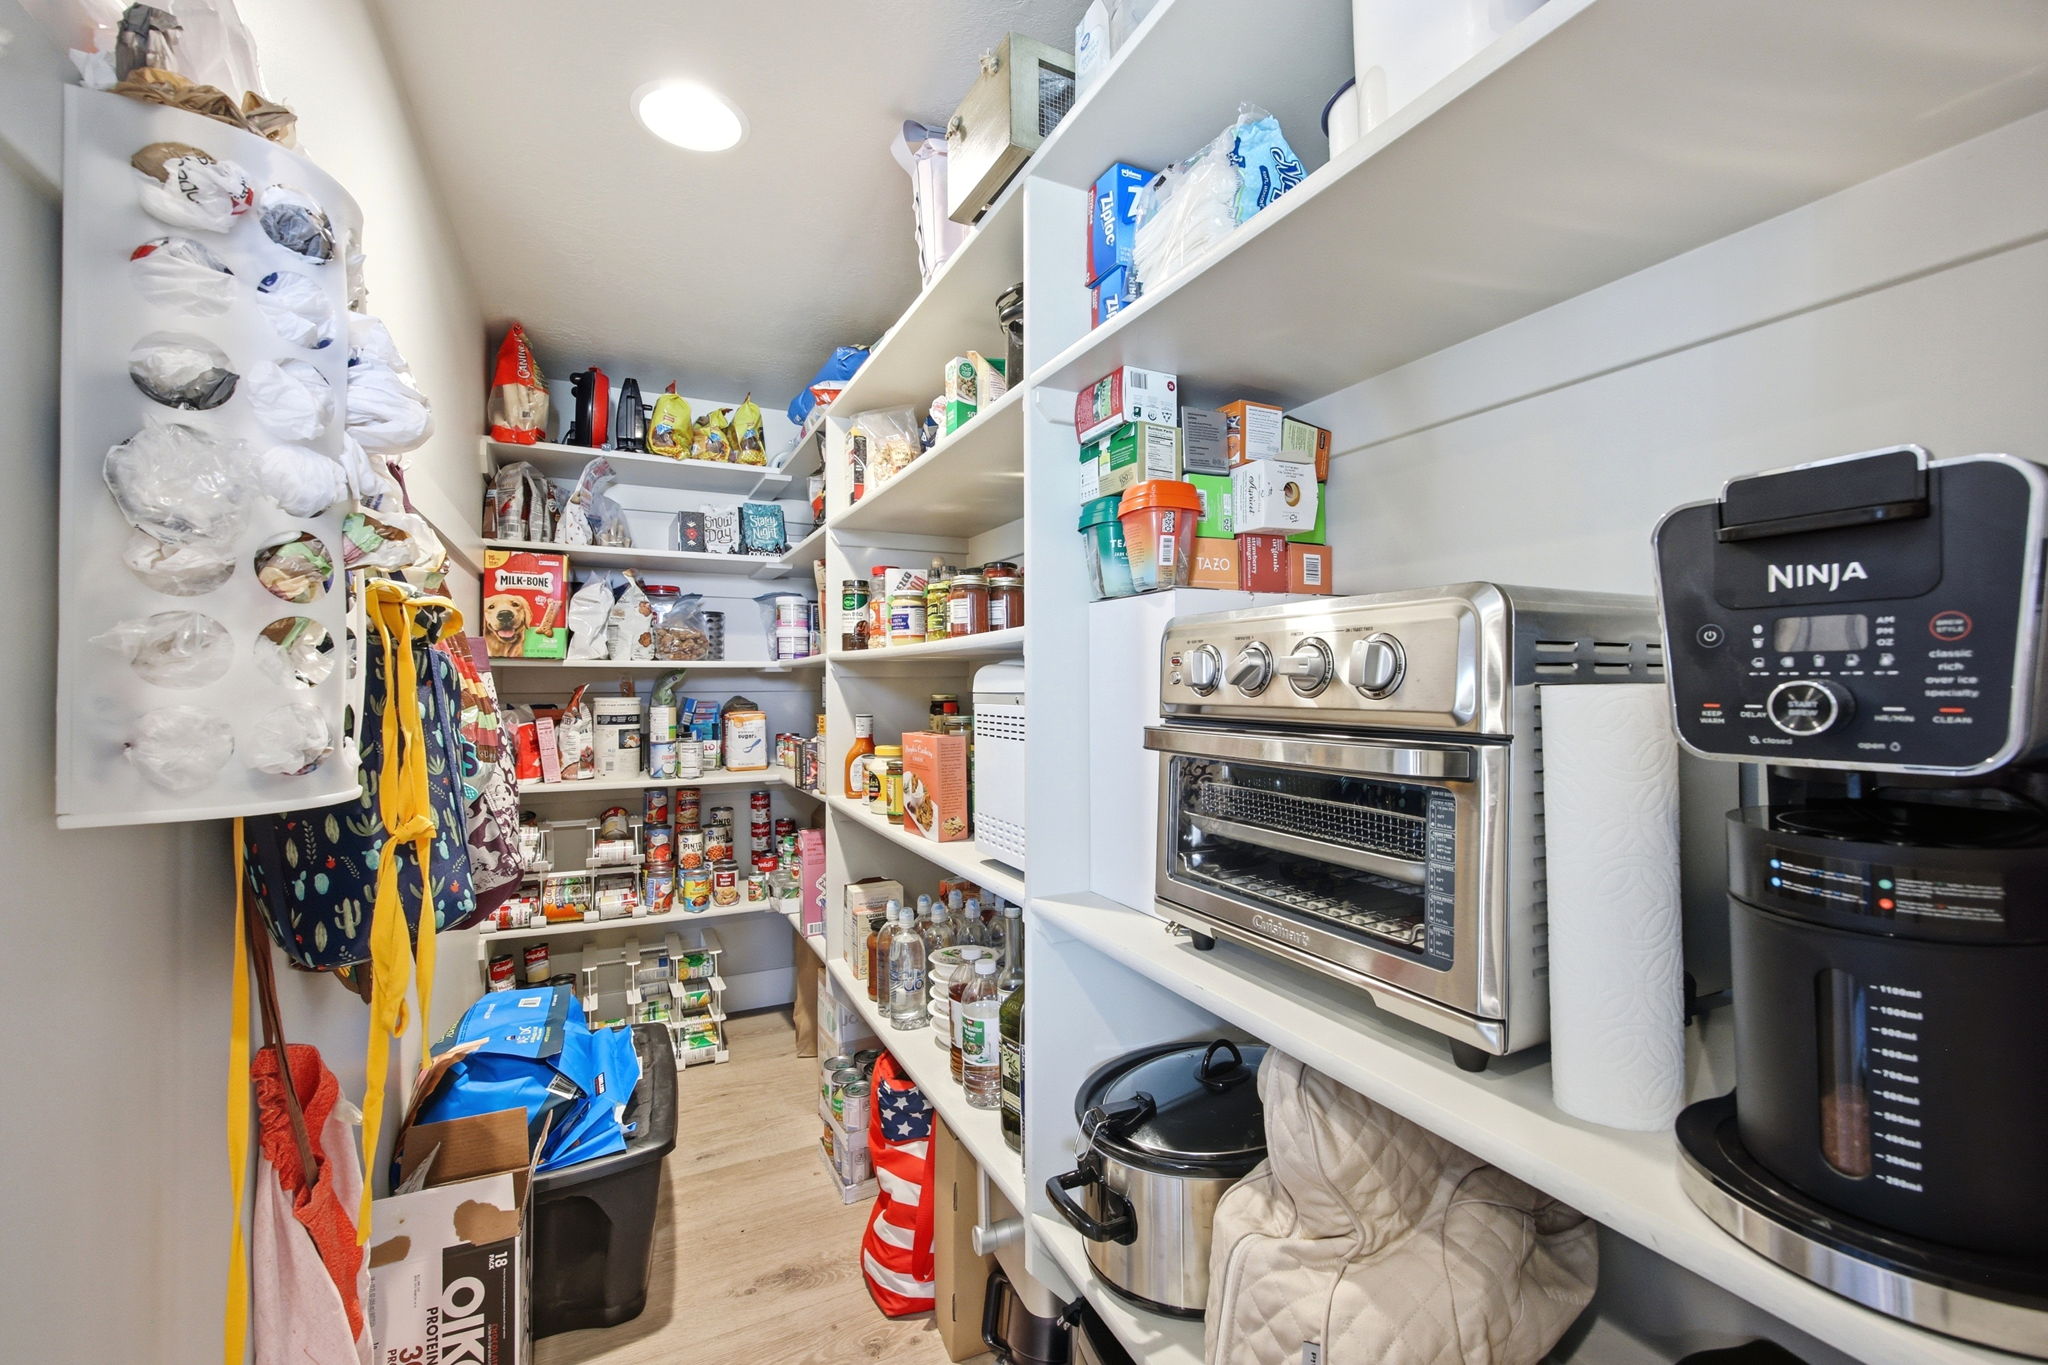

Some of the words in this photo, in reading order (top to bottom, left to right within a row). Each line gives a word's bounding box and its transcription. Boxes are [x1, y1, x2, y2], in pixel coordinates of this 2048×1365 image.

[1099, 190, 1115, 247] Ziploc
[704, 515, 734, 529] Snow
[705, 528, 732, 544] Day
[752, 526, 777, 540] Night
[1196, 557, 1231, 571] TAZO
[500, 575, 549, 588] MILK-BONE
[1767, 561, 1868, 593] NINJA
[1876, 638, 1895, 646] OZ
[1928, 649, 1974, 658] classic
[1937, 662, 1964, 671] rich
[1924, 676, 1954, 684] over
[1957, 675, 1979, 684] ice
[1932, 715, 1973, 724] CLEAN
[1762, 737, 1793, 745] closed
[1857, 741, 1887, 750] open
[1252, 914, 1310, 947] Cuisinart
[494, 1250, 509, 1269] 18
[441, 1276, 486, 1365] OIK
[426, 1306, 439, 1365] PROTEIN
[387, 1348, 398, 1365] PR
[399, 1345, 424, 1365] 3
